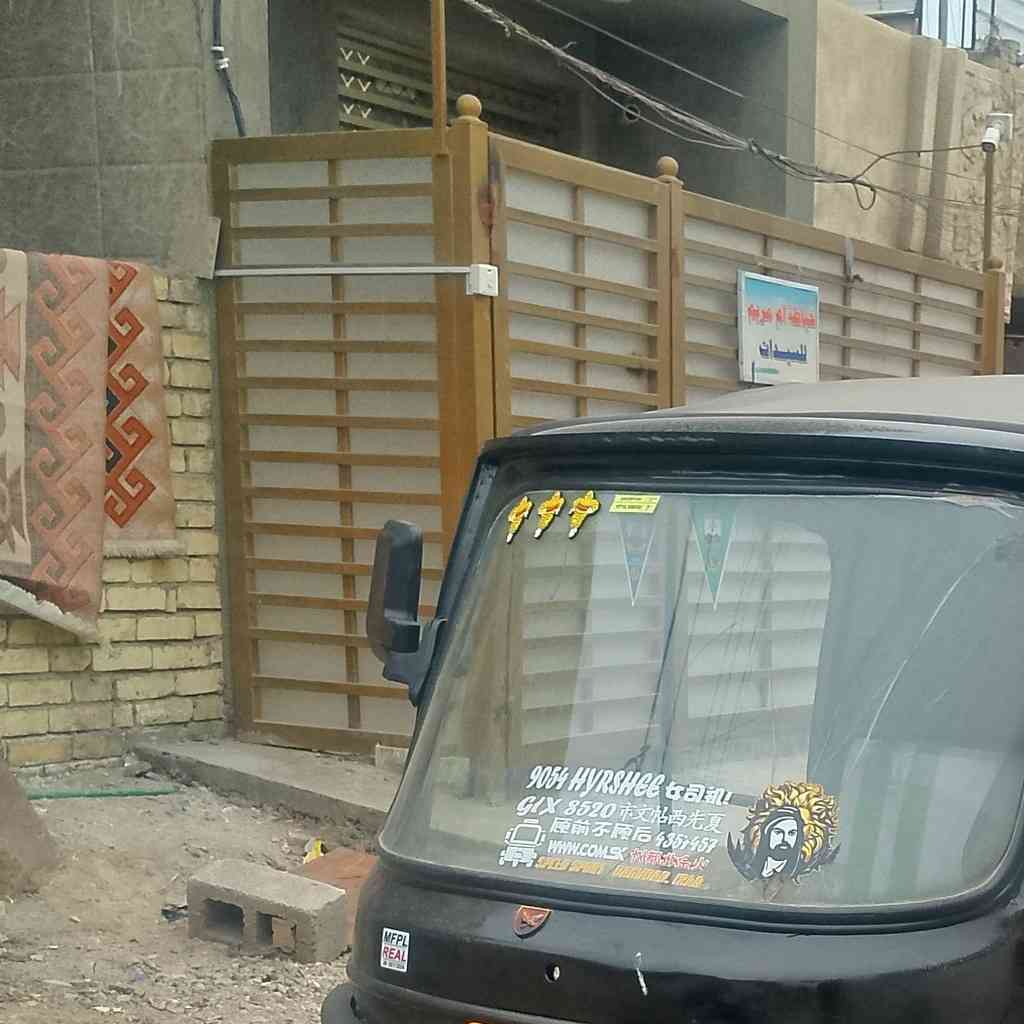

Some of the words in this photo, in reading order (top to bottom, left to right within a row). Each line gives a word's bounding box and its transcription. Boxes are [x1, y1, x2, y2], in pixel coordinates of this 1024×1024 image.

[526, 765, 568, 791] 9054
[563, 800, 618, 820] 8520
[383, 946, 407, 962] REAL
